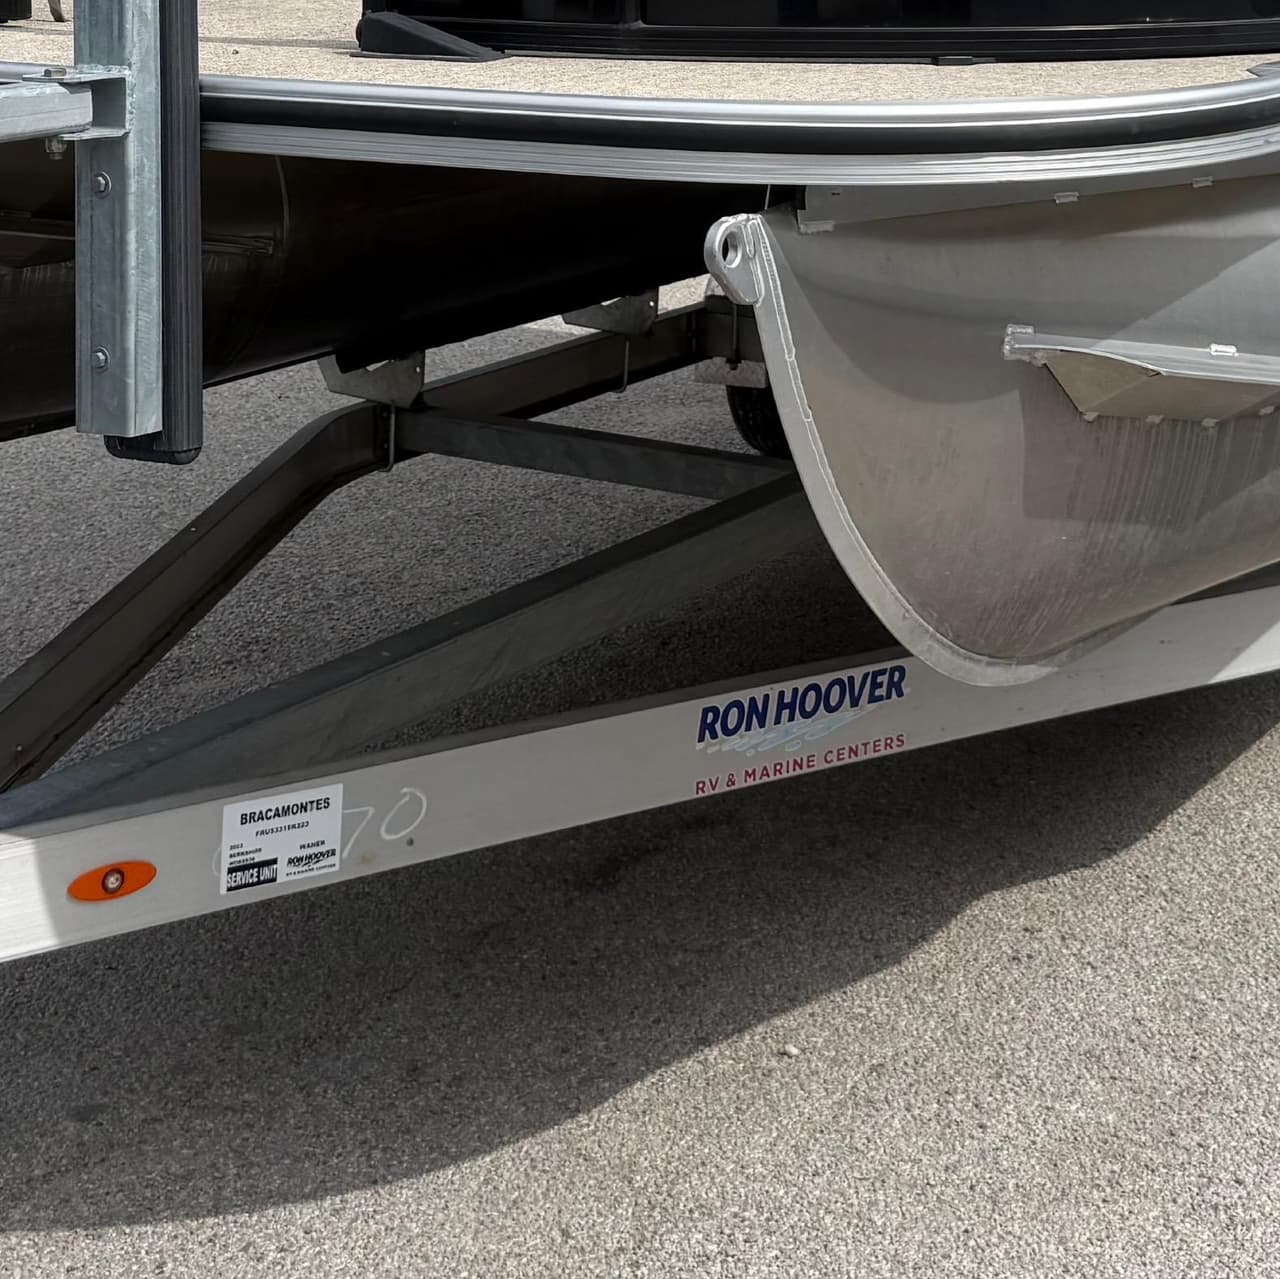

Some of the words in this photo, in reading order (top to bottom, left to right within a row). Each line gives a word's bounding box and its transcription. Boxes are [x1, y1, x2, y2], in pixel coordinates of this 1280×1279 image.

[697, 692, 770, 744] RON
[774, 664, 907, 726] HOOVER
[695, 776, 720, 795] RV
[726, 773, 737, 788] &
[744, 754, 817, 783] MARINE
[823, 734, 906, 765] CENTERS
[240, 797, 331, 825] BRACAMONTES
[227, 869, 258, 888] SERVICE
[259, 865, 277, 881] UNIT
